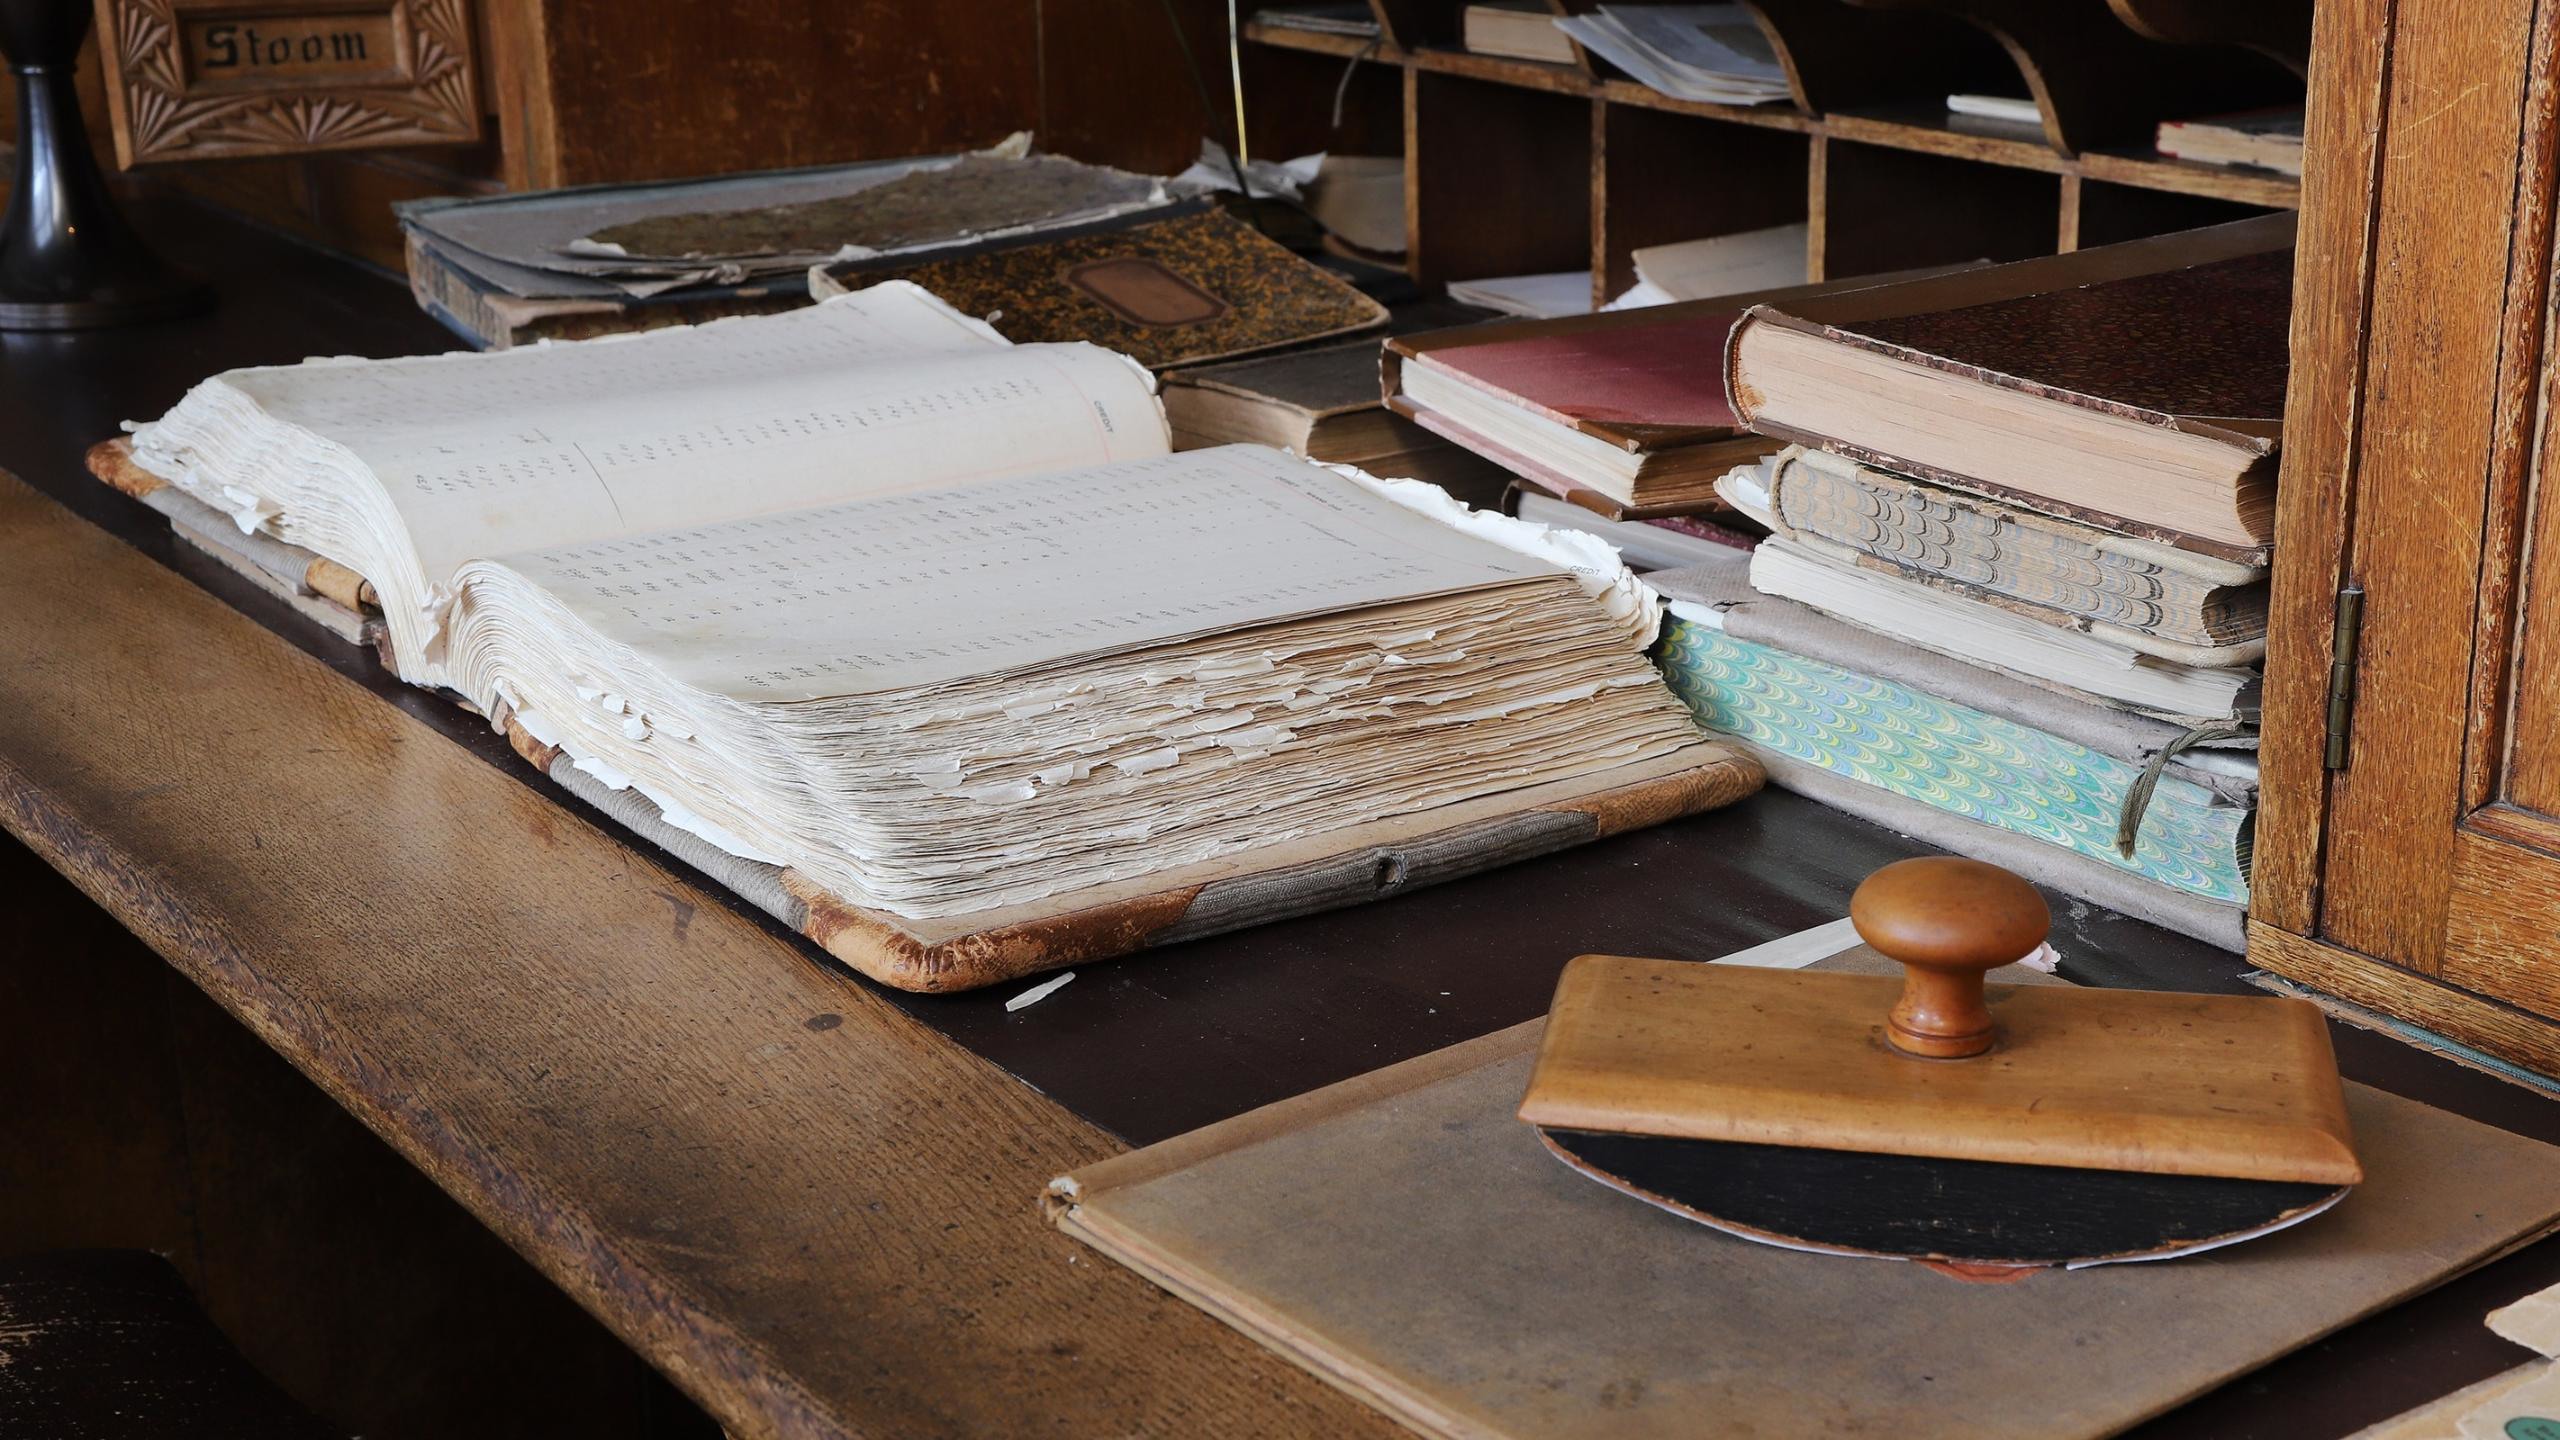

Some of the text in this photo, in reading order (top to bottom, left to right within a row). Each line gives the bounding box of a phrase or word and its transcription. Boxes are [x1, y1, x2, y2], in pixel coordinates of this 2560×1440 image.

[204, 25, 367, 68] Stoom
[1093, 400, 1114, 433] CREDIT
[1569, 565, 1600, 576] CREDIT
